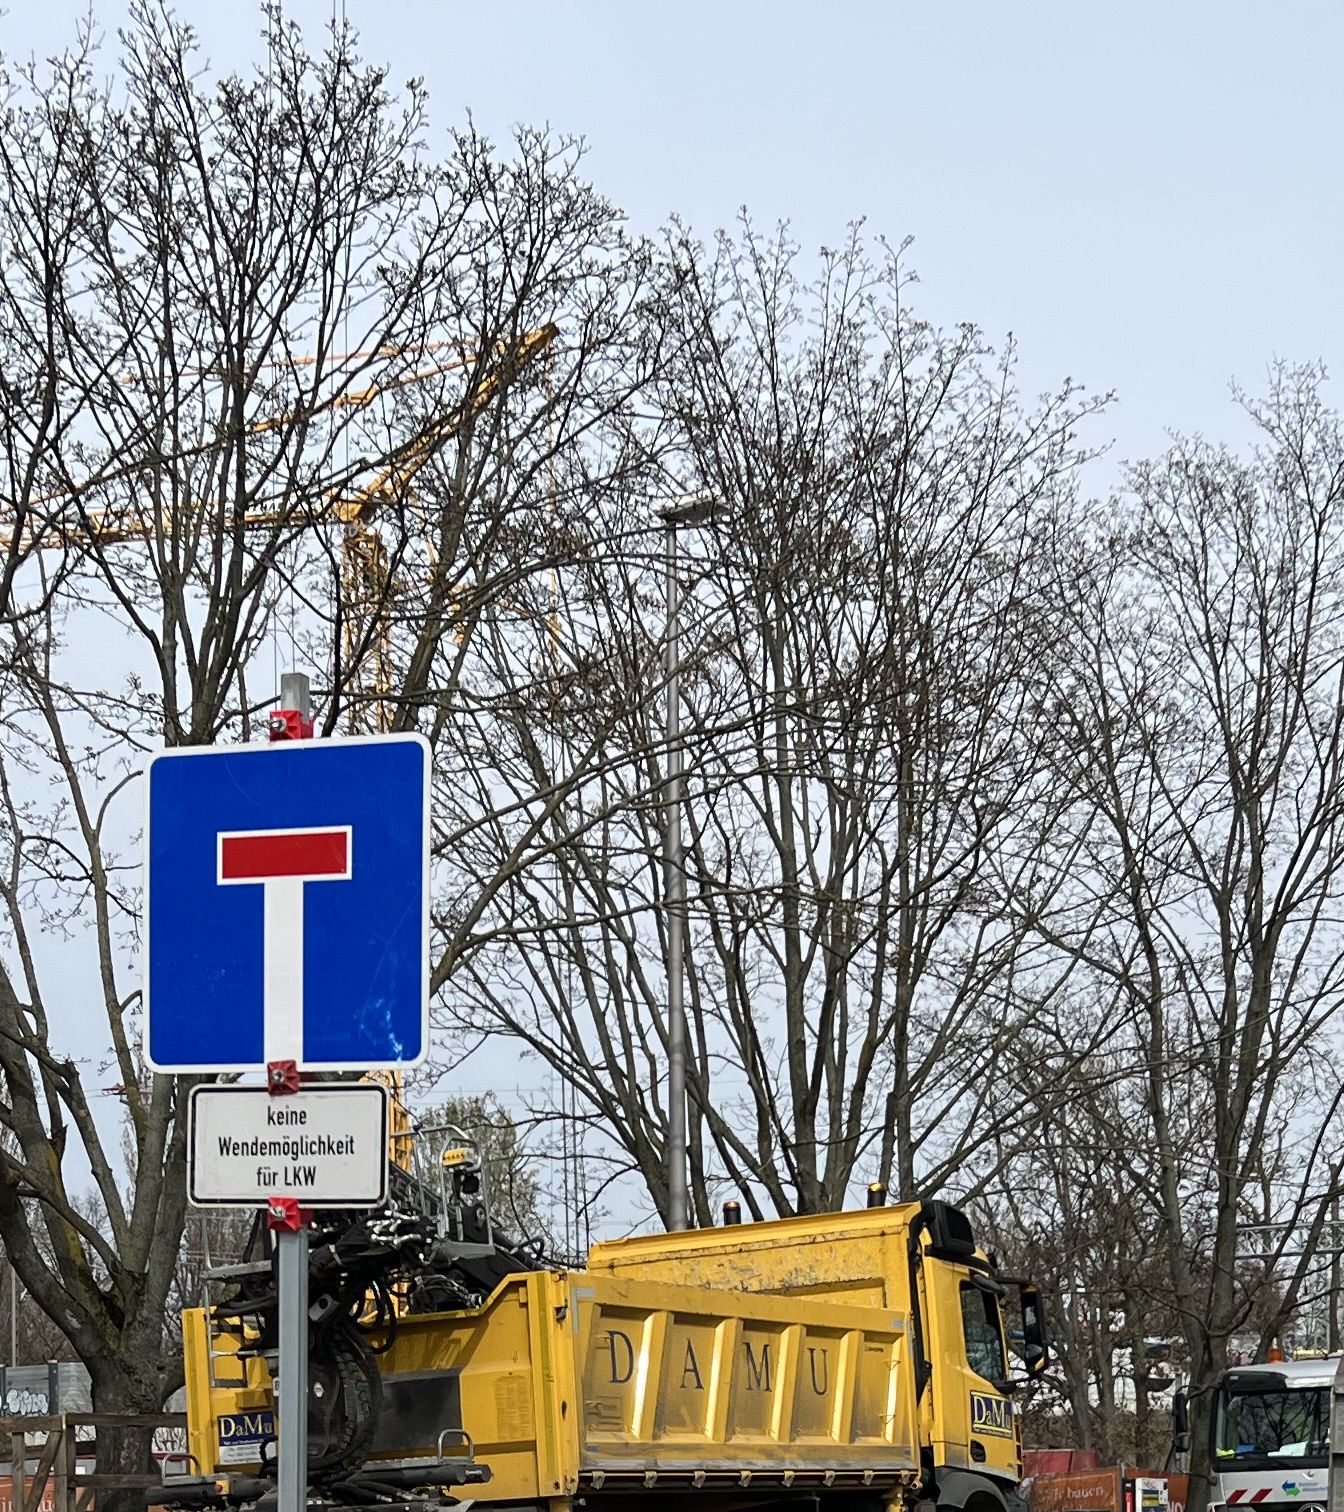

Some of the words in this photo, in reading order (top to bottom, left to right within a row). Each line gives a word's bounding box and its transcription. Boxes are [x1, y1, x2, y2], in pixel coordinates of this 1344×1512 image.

[267, 1106, 307, 1126] keine
[218, 1134, 355, 1161] Wendemöglichkeit
[257, 1167, 278, 1187] für
[284, 1166, 316, 1186] LKW
[220, 1414, 273, 1438] DaMu
